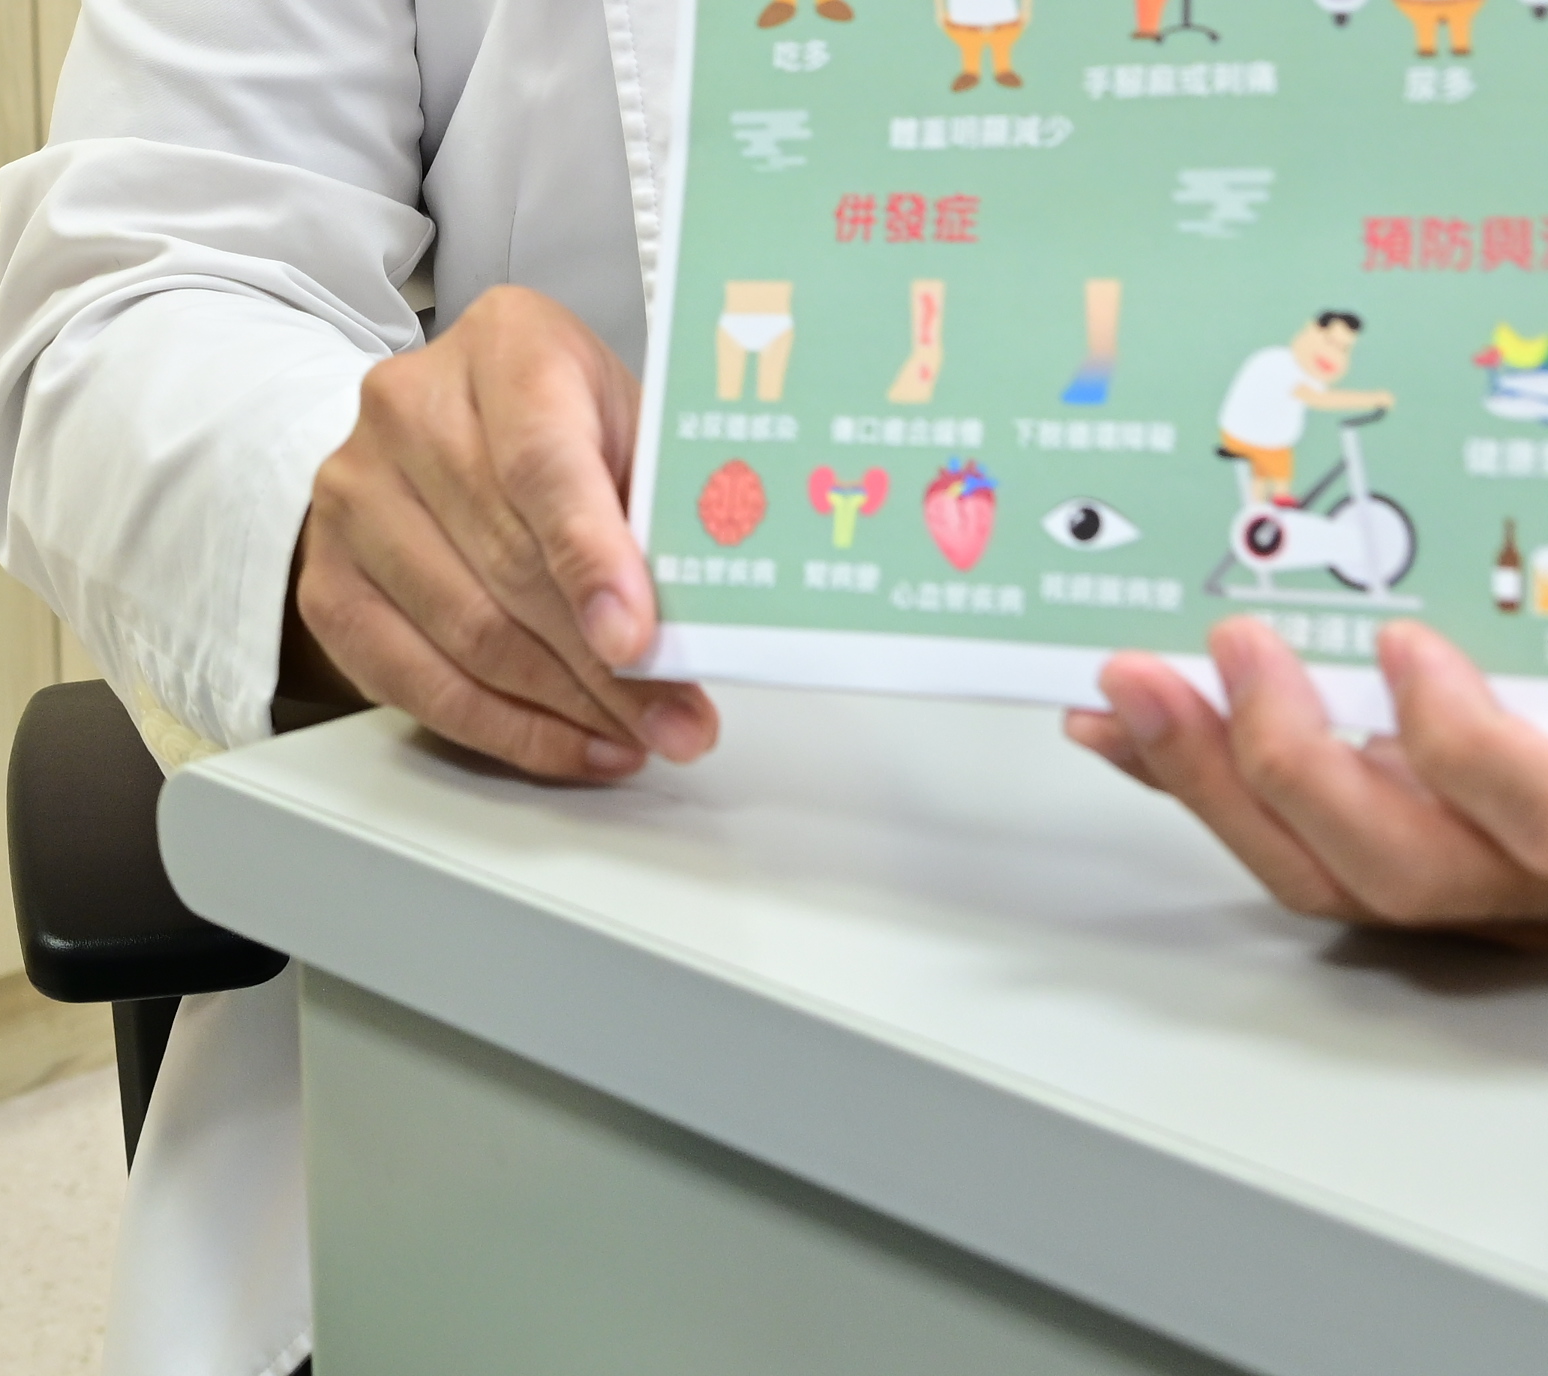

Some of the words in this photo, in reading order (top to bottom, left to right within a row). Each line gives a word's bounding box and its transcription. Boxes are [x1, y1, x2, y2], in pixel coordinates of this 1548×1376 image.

[773, 39, 830, 71] 吃多
[1406, 66, 1474, 101] 尿多
[890, 115, 1071, 149] 體重明顯減少
[835, 193, 978, 242] 併發症
